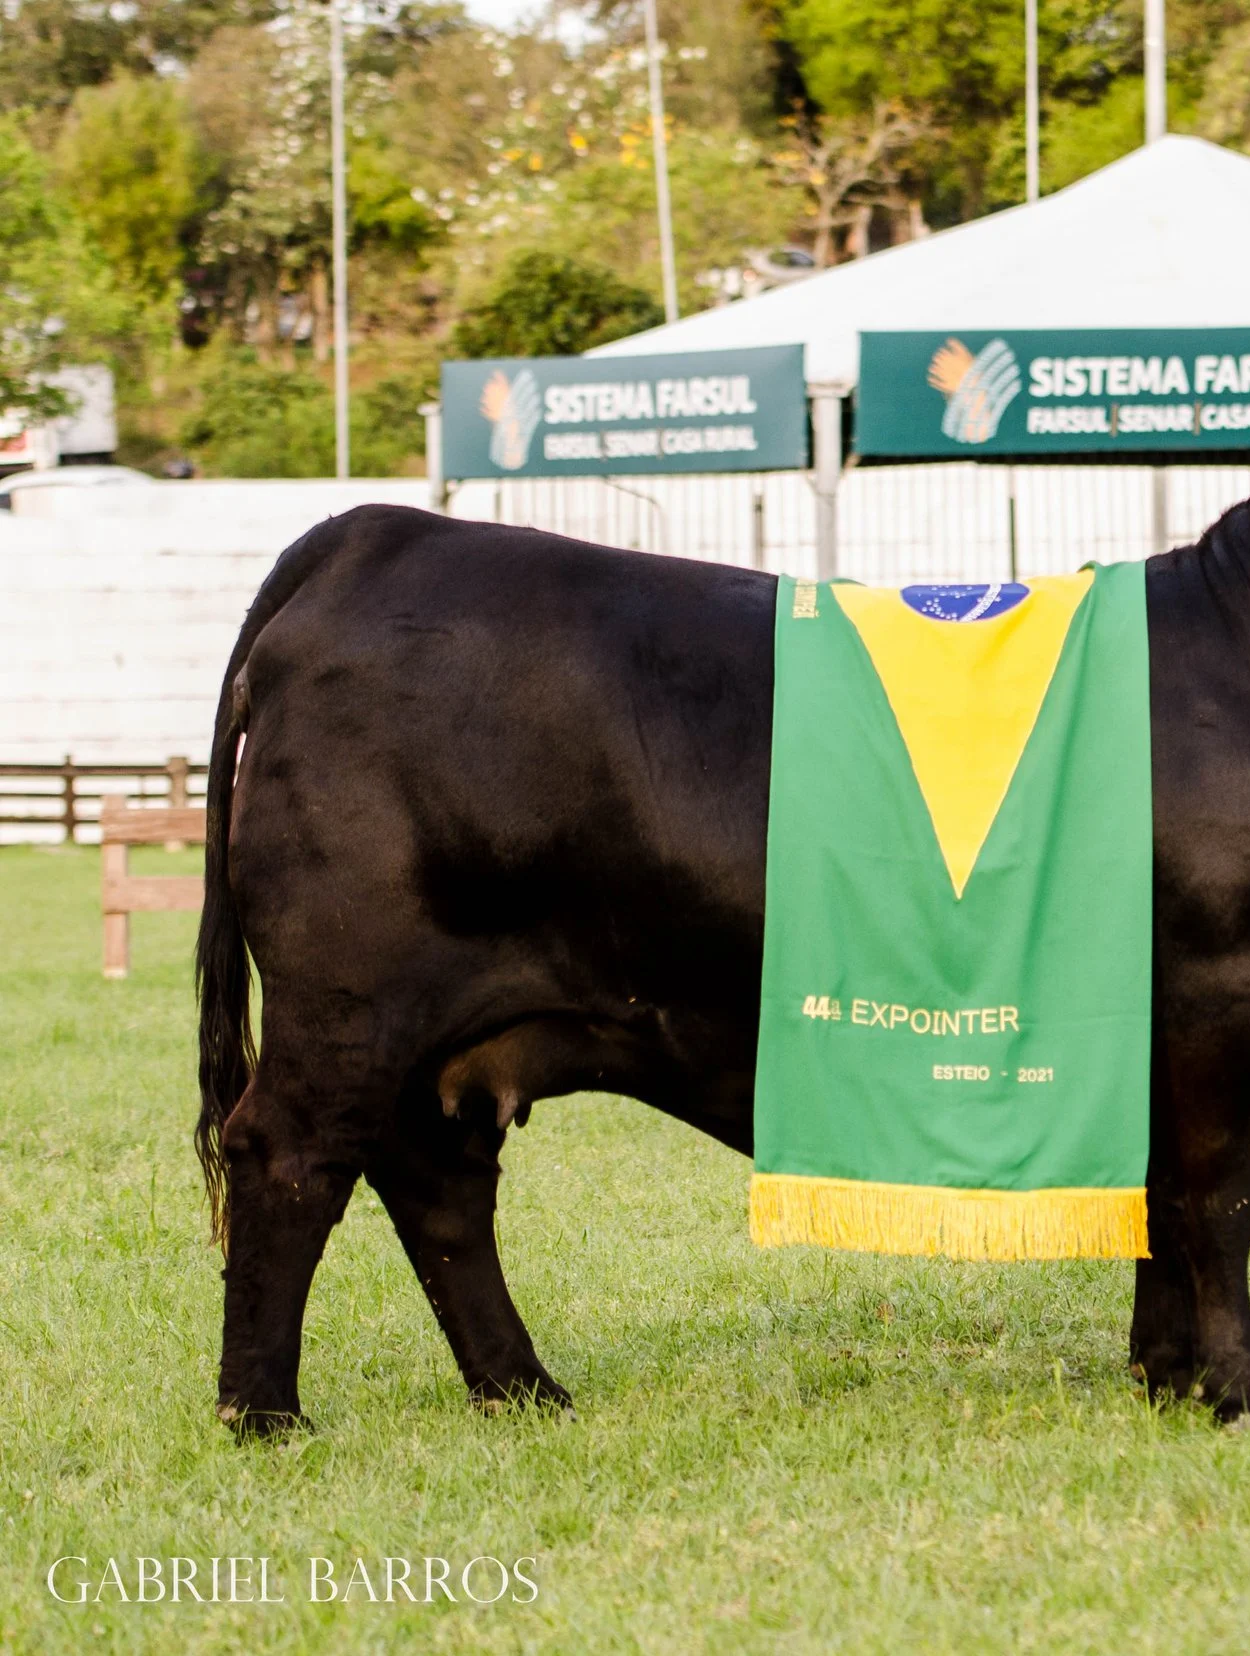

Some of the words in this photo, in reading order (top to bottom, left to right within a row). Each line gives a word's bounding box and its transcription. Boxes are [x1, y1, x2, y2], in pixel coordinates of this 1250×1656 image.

[1029, 356, 1190, 397] SISTEMA
[544, 381, 655, 424] SISTEMA
[655, 375, 758, 418] FARSUL
[1027, 405, 1111, 434] FARSUL
[1116, 403, 1194, 432] SENAR
[851, 998, 1019, 1036] EXPOINTER
[932, 1065, 990, 1082] ESTEIO
[1017, 1067, 1054, 1083] 2021
